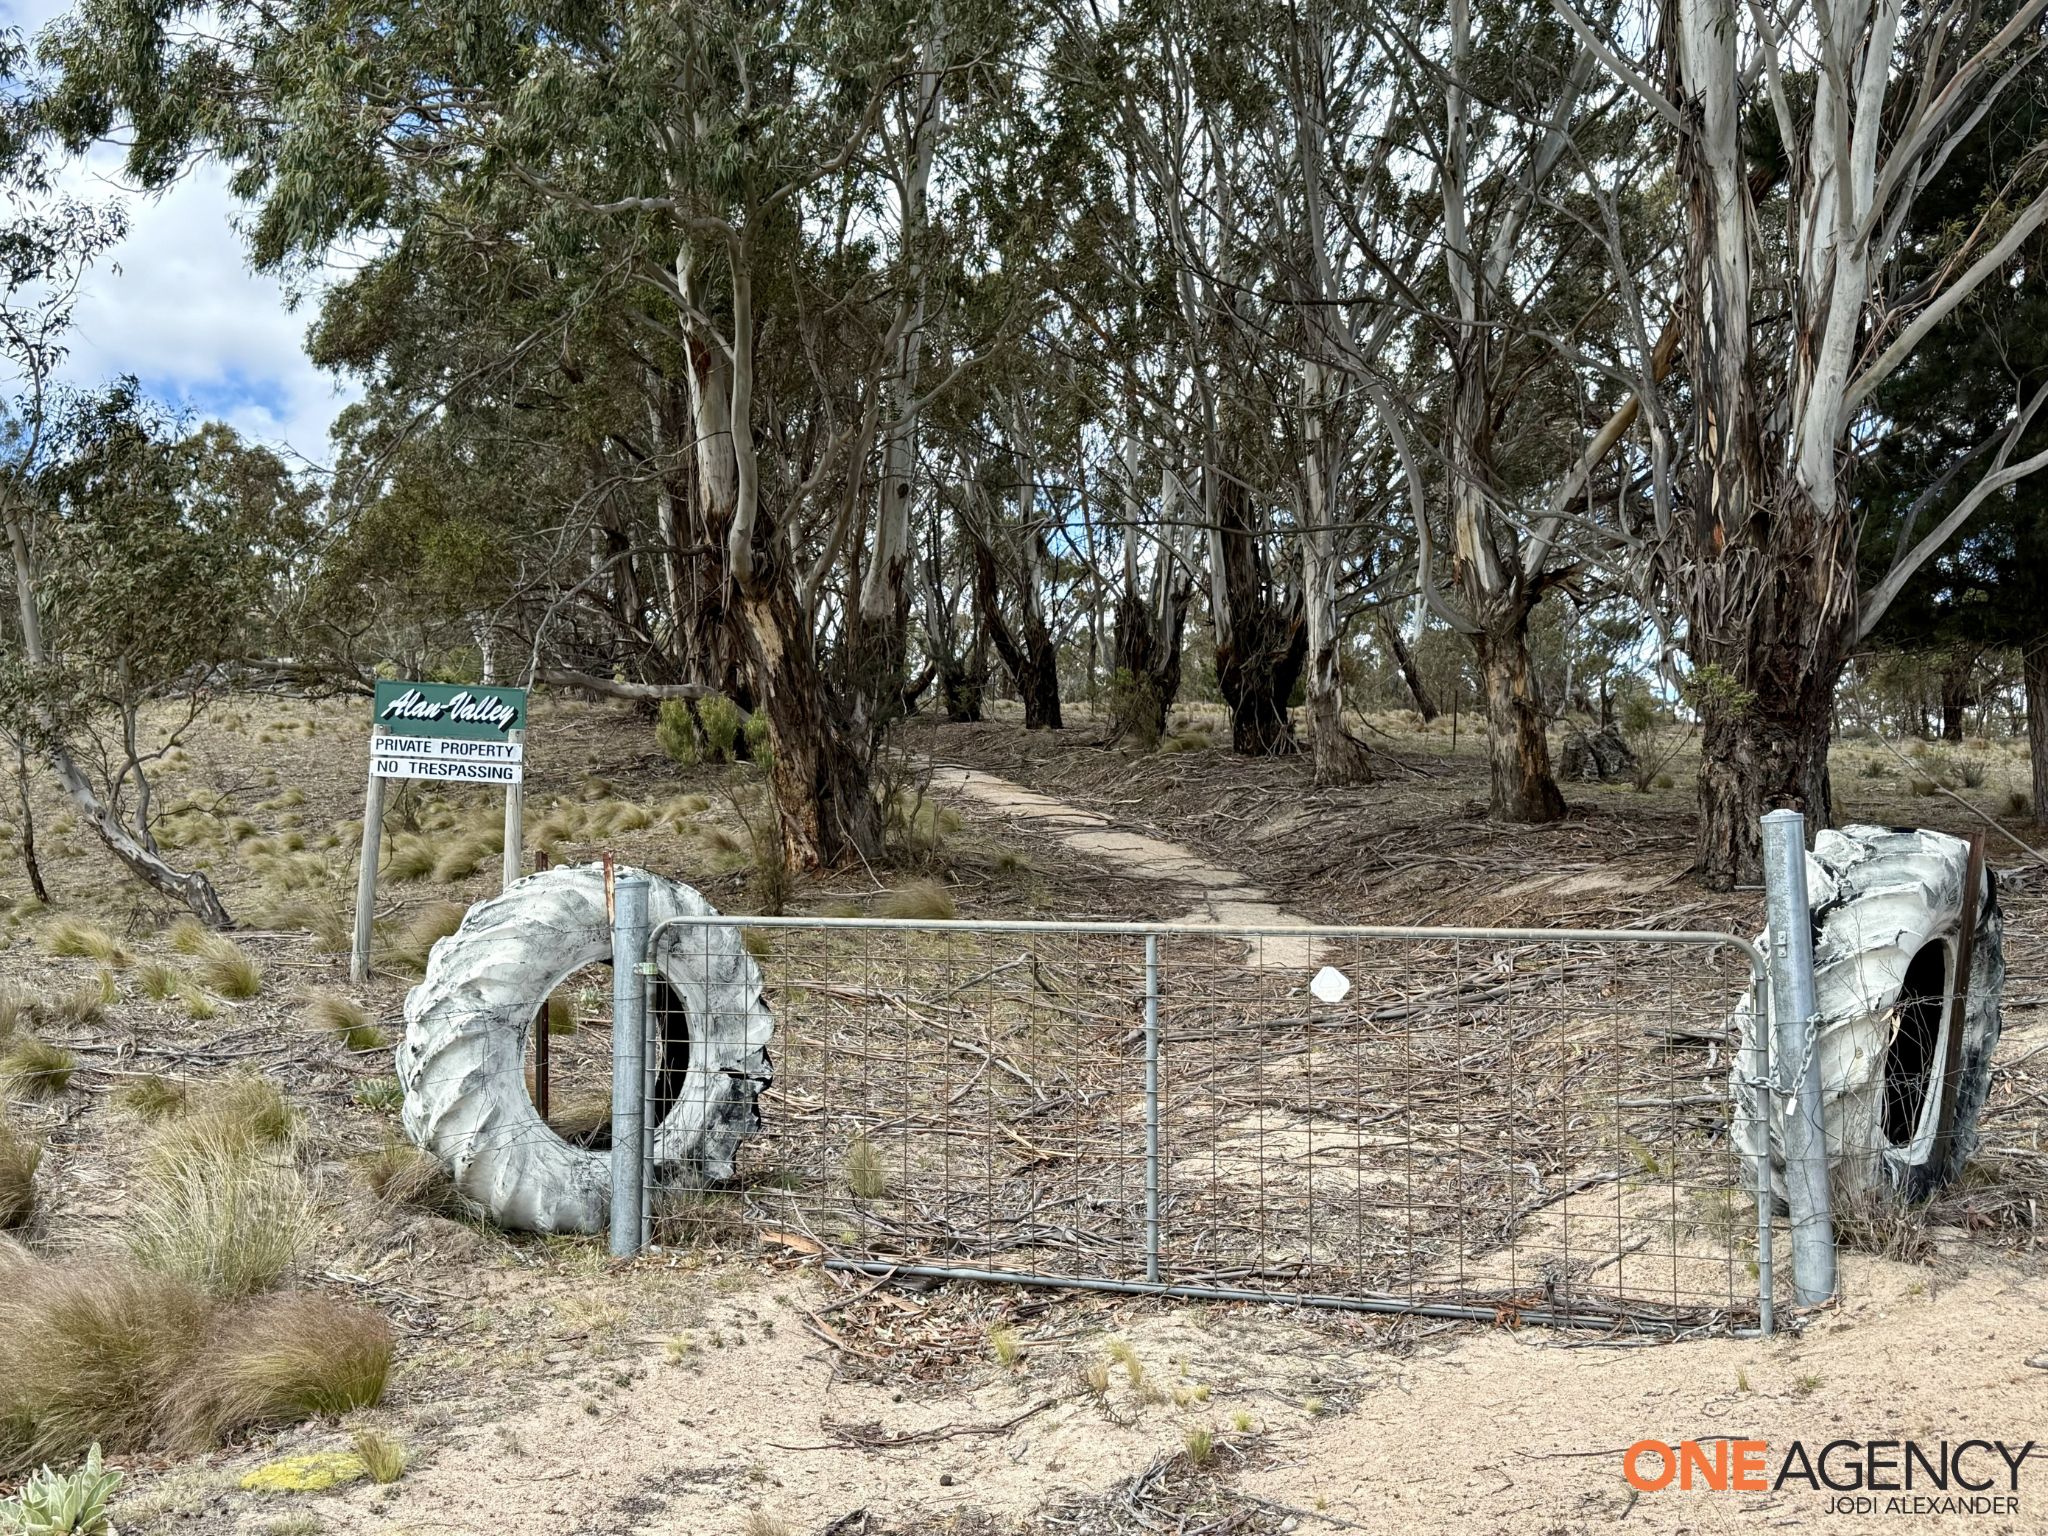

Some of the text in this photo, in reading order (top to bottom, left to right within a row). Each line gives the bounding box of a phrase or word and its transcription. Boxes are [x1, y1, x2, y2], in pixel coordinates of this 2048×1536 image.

[375, 738, 514, 758] PRIVATE PROPERTY
[377, 760, 513, 780] NO TRESPASSING
